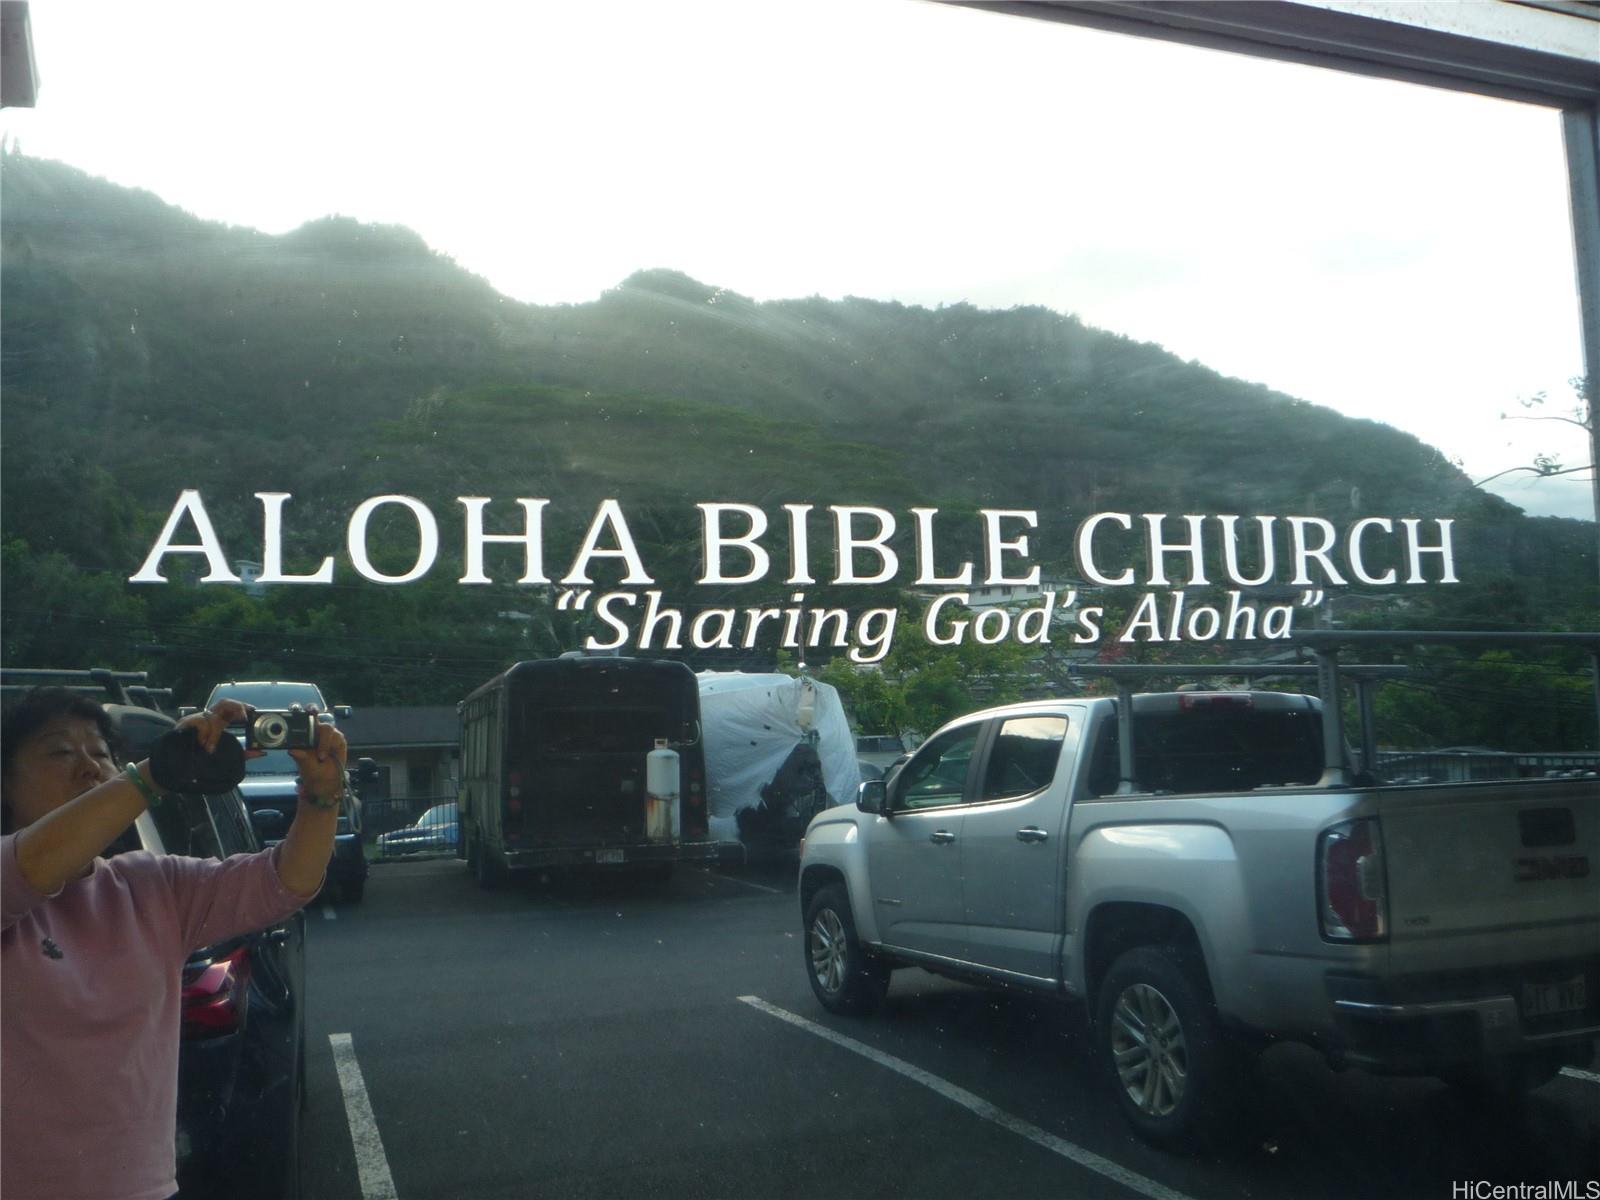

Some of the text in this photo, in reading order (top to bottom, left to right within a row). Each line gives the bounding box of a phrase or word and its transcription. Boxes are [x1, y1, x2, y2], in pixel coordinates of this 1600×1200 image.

[129, 489, 1459, 586] ALOHA BIBLE CHURCH
[557, 588, 1324, 664] “Sharing God’s Aloha”
